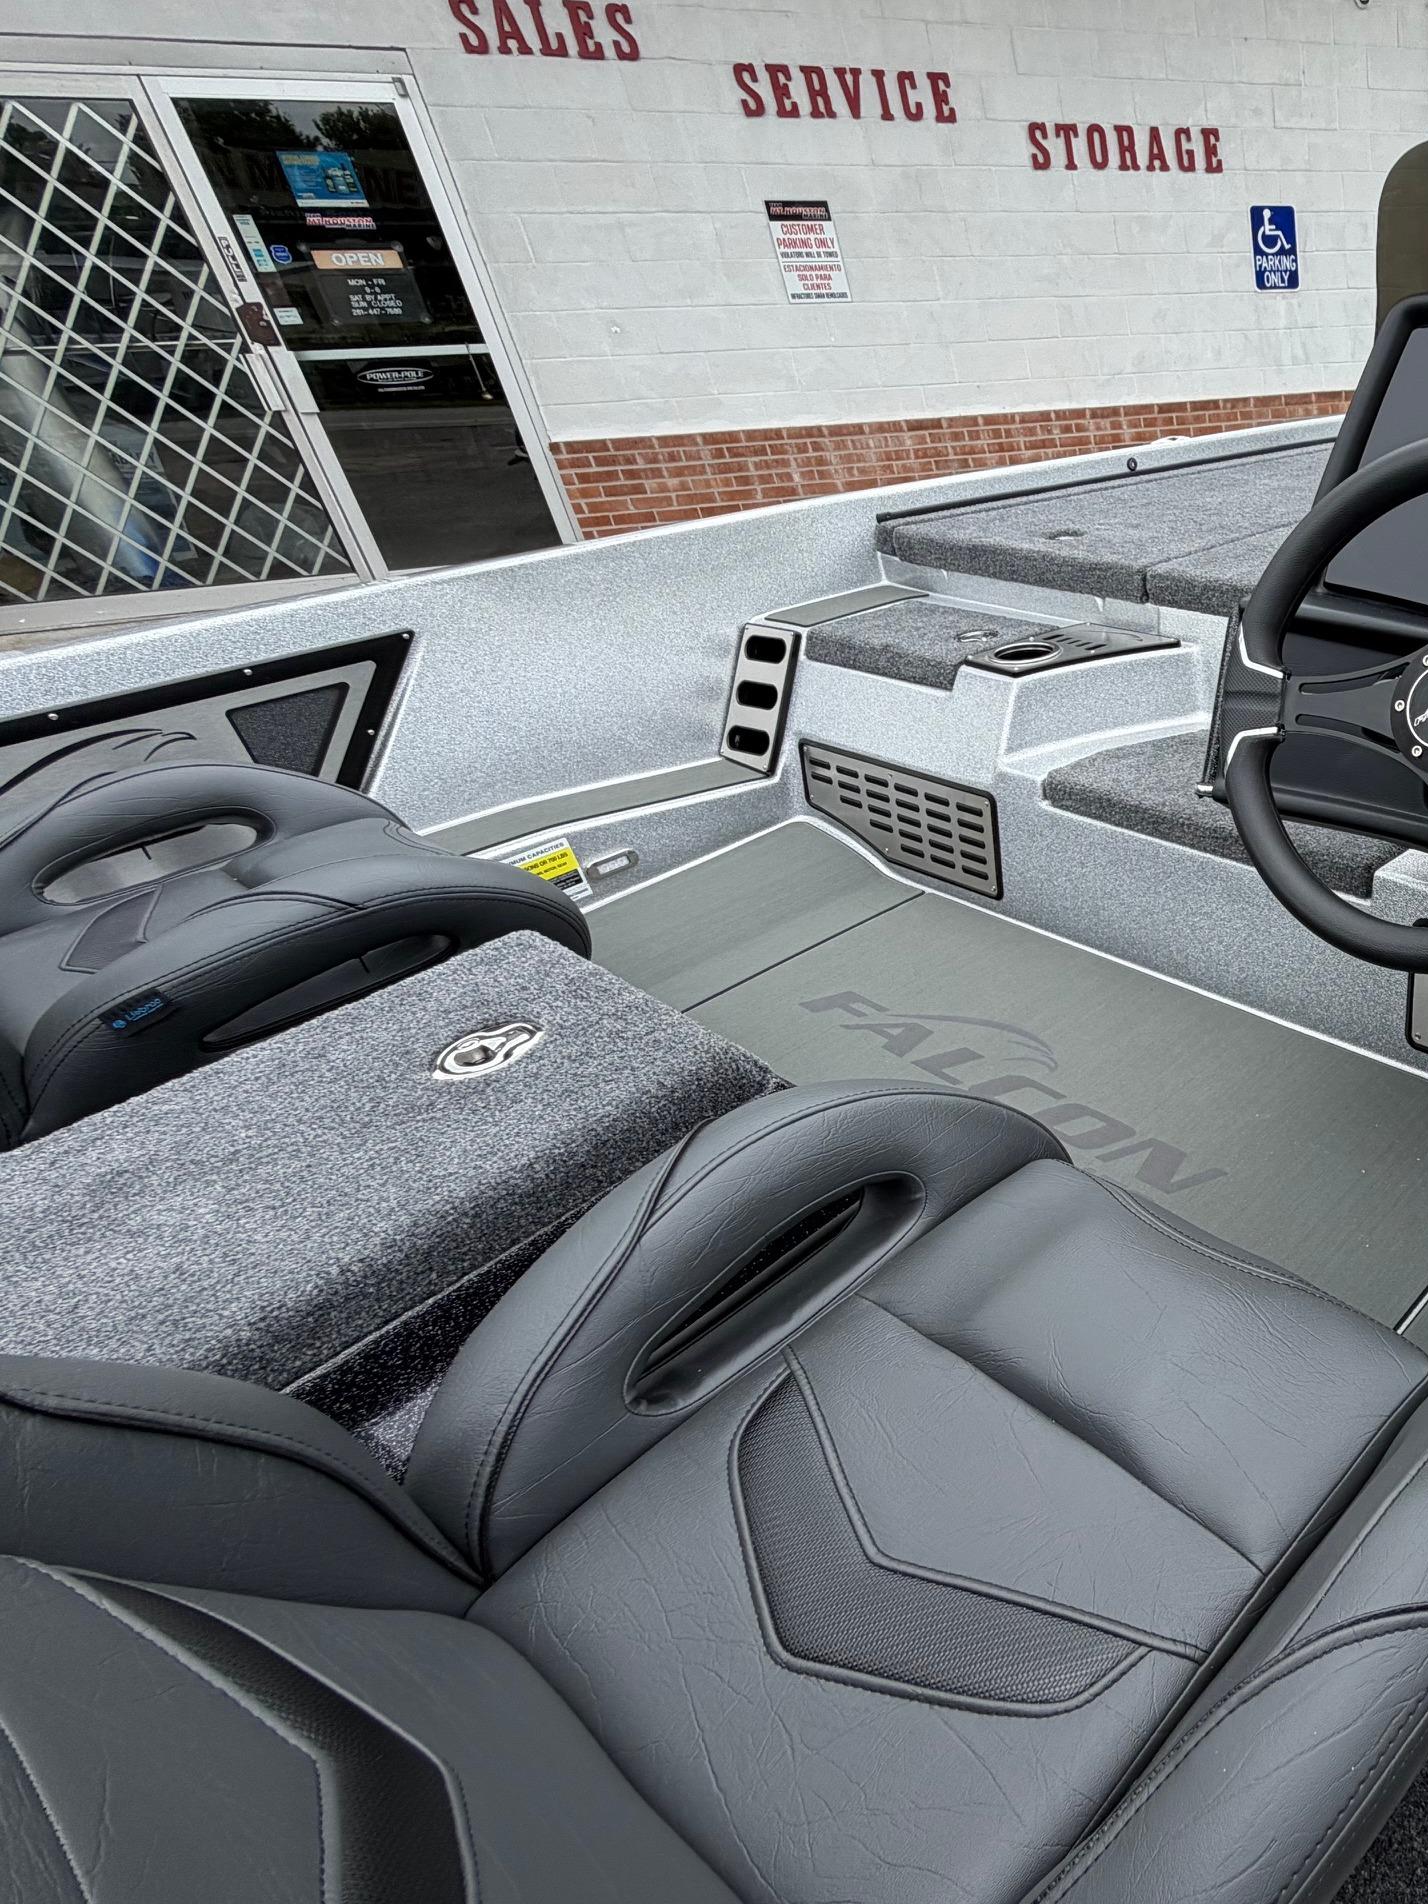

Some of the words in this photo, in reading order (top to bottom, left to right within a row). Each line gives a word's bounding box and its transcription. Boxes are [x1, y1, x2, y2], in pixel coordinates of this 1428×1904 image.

[449, 0, 640, 61] SALES
[732, 62, 958, 124] SERVICE
[1027, 121, 1224, 174] STORAGE
[780, 223, 826, 236] CUSTOMER
[776, 237, 814, 250] PARKING
[814, 237, 836, 249] ONLY
[331, 252, 385, 267] OPEN
[780, 251, 805, 259] VIOLATORS
[783, 263, 842, 273] ESTACIONAMIENTO
[1256, 254, 1297, 272] PARKING
[346, 278, 367, 286] MON
[373, 278, 386, 286] FRI
[797, 273, 815, 282] SOLO
[815, 273, 833, 281] PARA
[1264, 271, 1290, 287] ONLY
[802, 282, 832, 291] CLIENTES
[349, 294, 362, 302] SAT
[371, 300, 403, 308] CLOSED
[365, 370, 424, 380] POWER-POLE
[526, 842, 565, 860] CAPACITIES
[556, 852, 569, 861] LBS
